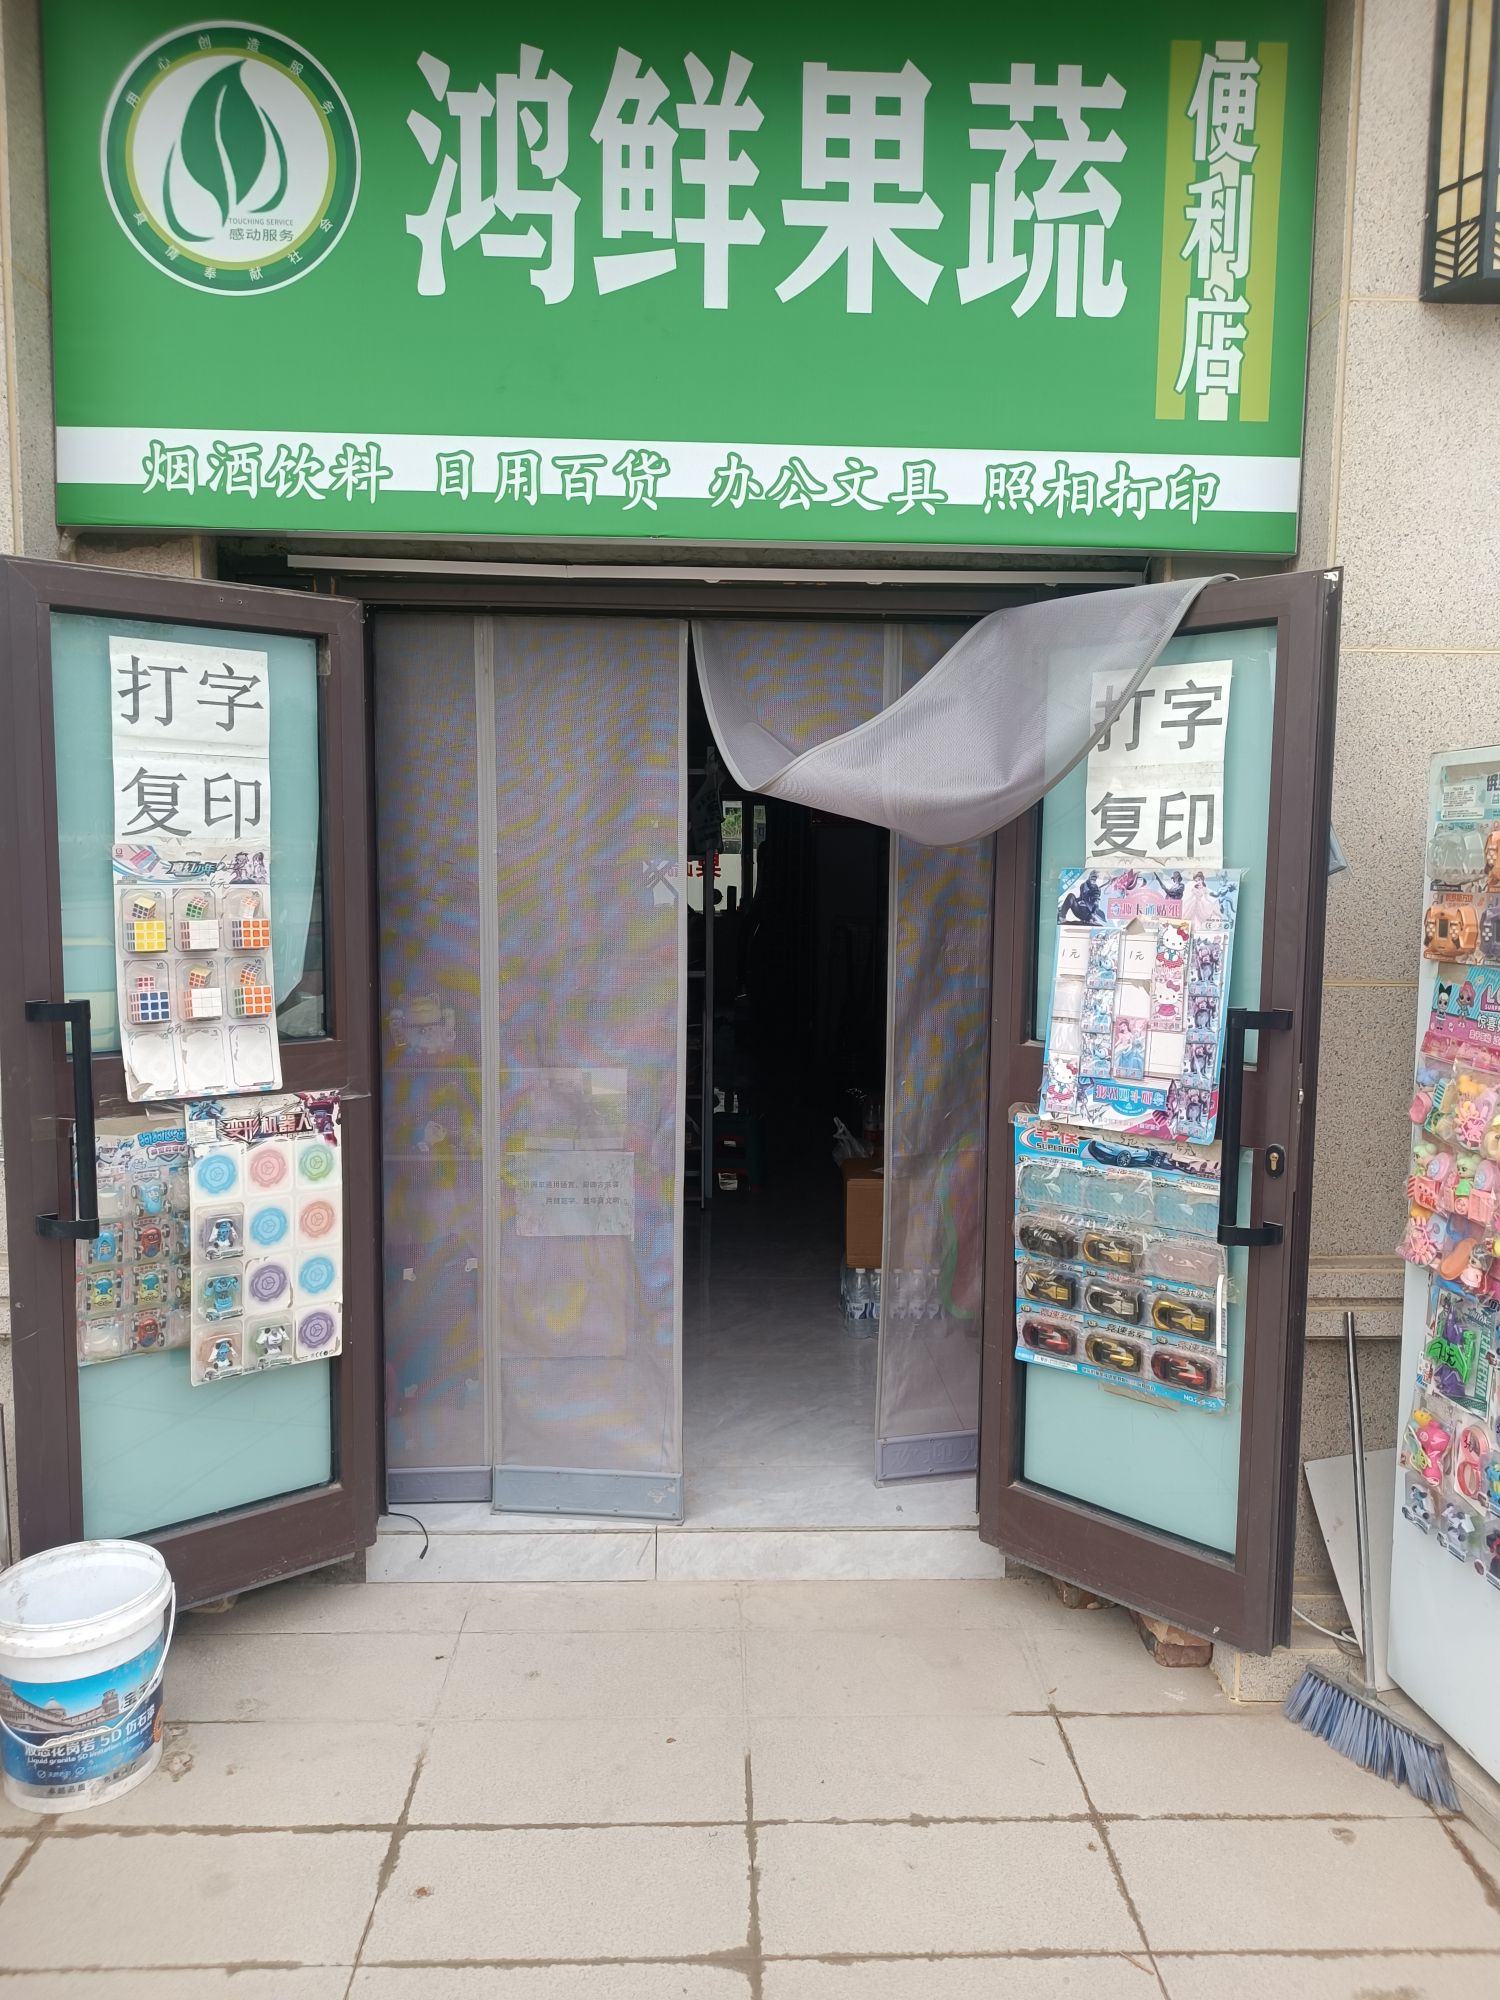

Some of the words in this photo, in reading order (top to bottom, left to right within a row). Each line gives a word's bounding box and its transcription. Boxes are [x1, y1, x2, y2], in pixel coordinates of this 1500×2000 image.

[406, 43, 1127, 318] 鸿鲜果蔬
[229, 218, 264, 226] TOUCHING
[229, 228, 294, 242] 感动服务
[1175, 54, 1260, 394] 便利店
[142, 440, 391, 504] 烟酒饮料
[436, 449, 670, 510] 日用百货
[709, 456, 947, 517] 办公文具
[984, 463, 1220, 524] 照相打印
[117, 655, 264, 731] 打字
[1094, 680, 1222, 752] 打字
[121, 767, 262, 839] 复印
[1091, 791, 1215, 857] 复印
[1129, 950, 1145, 961] 1元
[225, 1113, 314, 1142] 变形机器人
[27, 1757, 48, 1765] Liquid
[49, 1756, 77, 1765] granite
[100, 1727, 122, 1747] 5D
